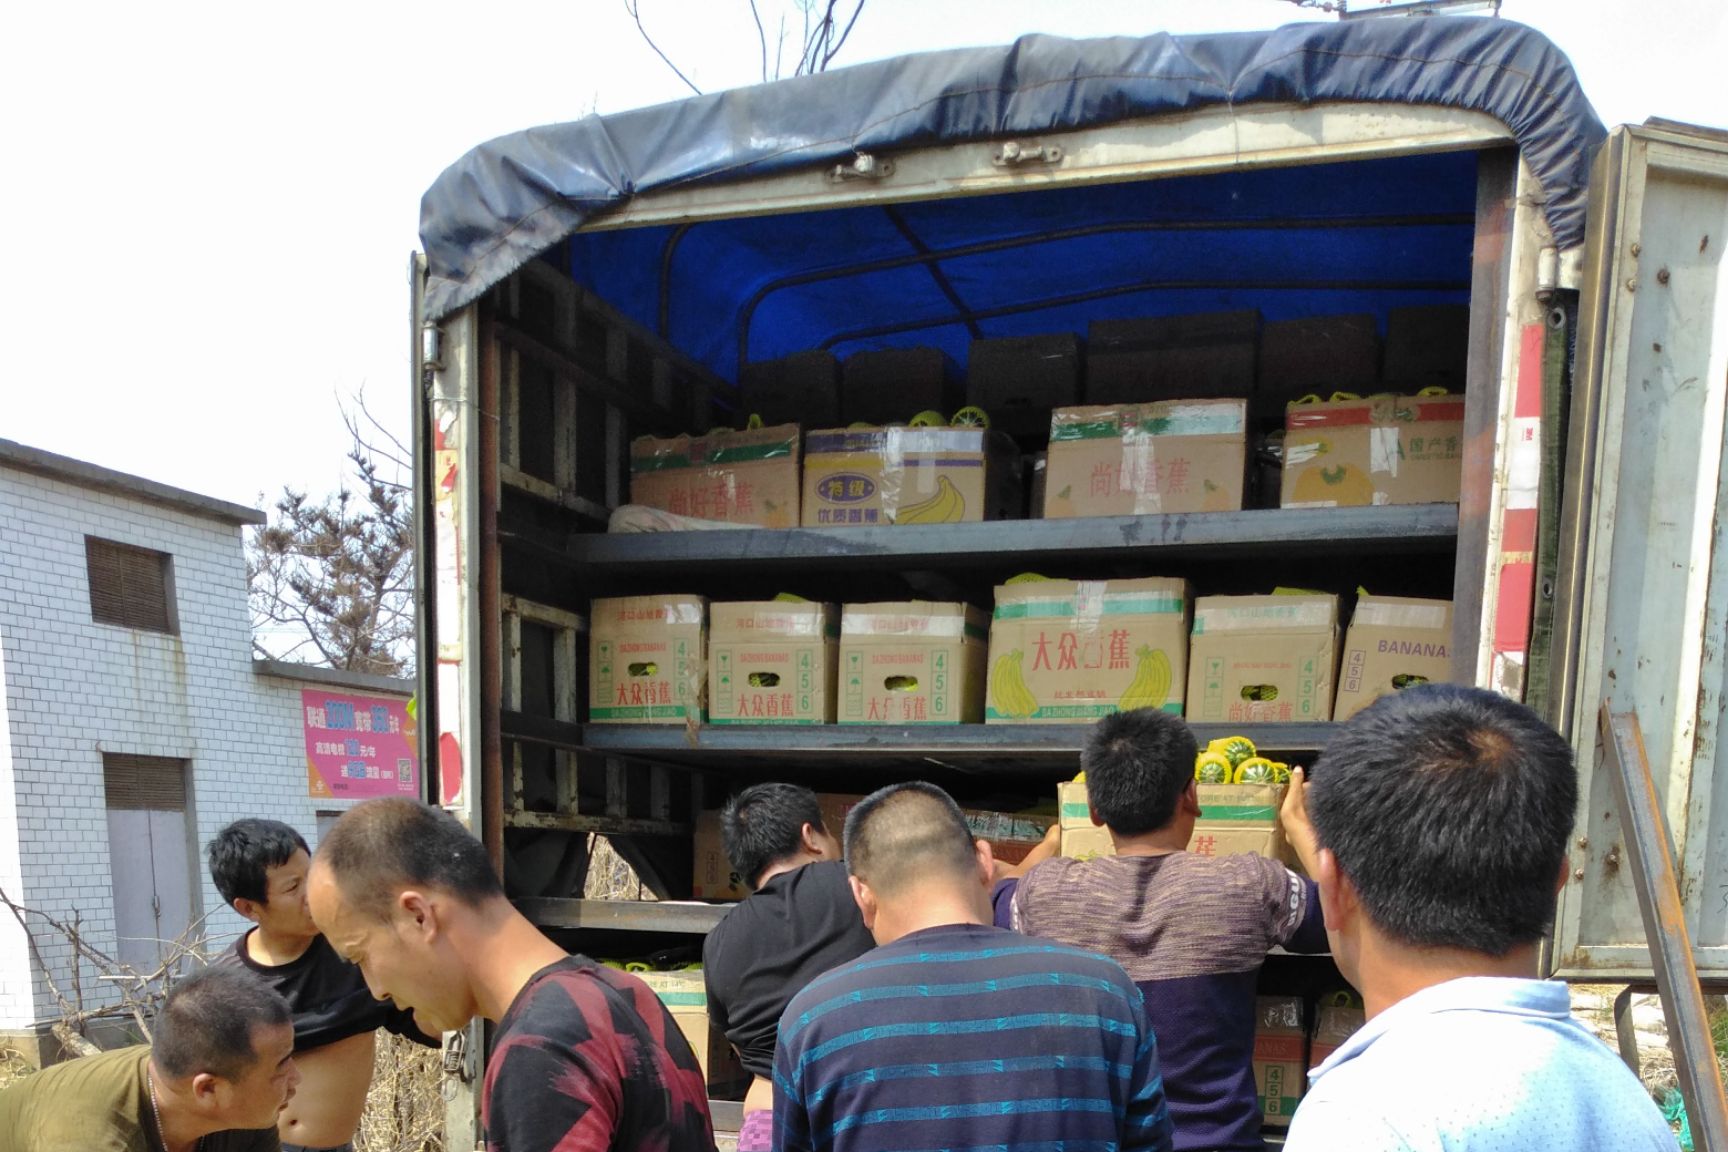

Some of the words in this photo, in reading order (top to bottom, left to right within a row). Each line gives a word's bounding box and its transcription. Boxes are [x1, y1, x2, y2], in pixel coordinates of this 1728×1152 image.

[828, 479, 865, 498] 特级
[818, 508, 878, 524] 优质香蕉
[1377, 639, 1451, 659] BANANA
[800, 653, 809, 669] 4
[935, 653, 944, 669] 4
[1352, 652, 1361, 663] 4
[1303, 659, 1313, 674] 4
[1350, 666, 1359, 676] 5
[678, 681, 686, 696] 6
[801, 673, 809, 689] 5
[935, 674, 944, 690] 5
[1303, 680, 1312, 694] 5
[1348, 679, 1356, 690] 6
[737, 692, 794, 717] 大众香蕉
[801, 695, 809, 710] 6
[935, 696, 943, 712] 6
[1301, 699, 1310, 713] 6
[1269, 1068, 1280, 1081] 4
[1269, 1084, 1279, 1096] 5
[1268, 1100, 1278, 1113] 6
